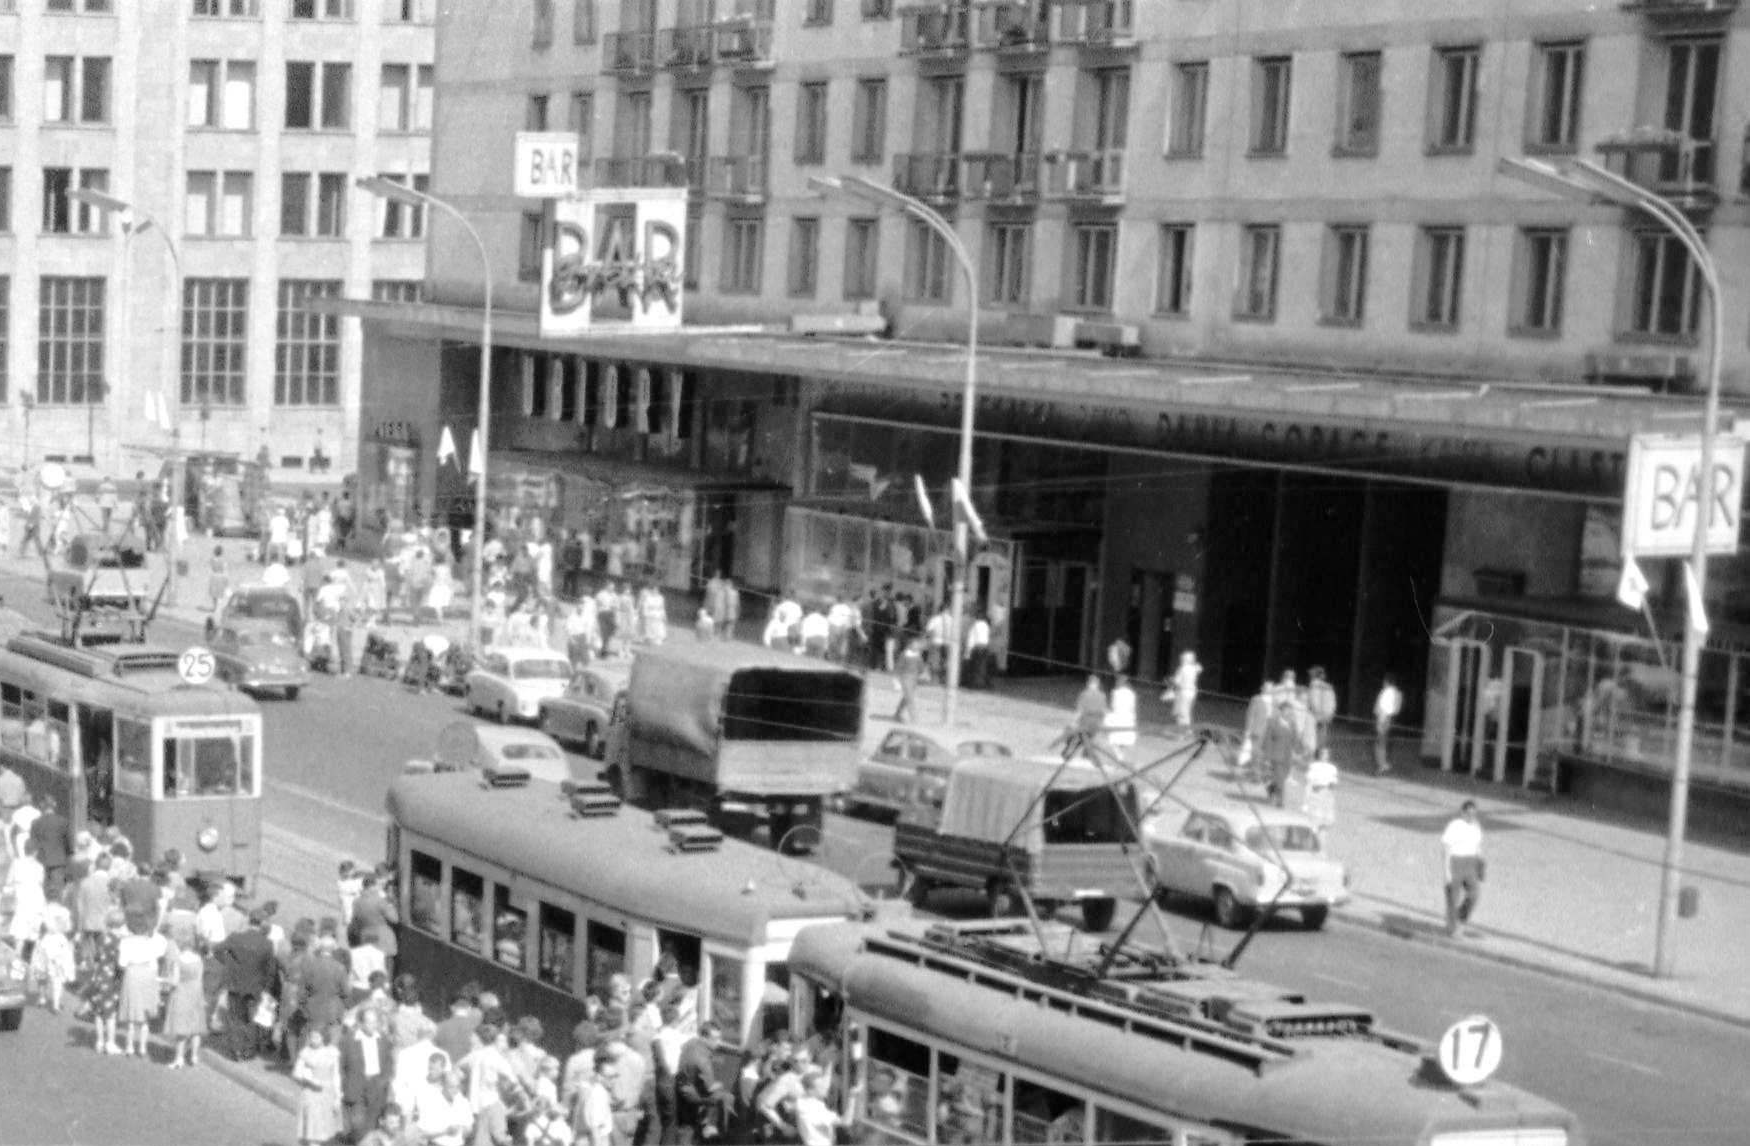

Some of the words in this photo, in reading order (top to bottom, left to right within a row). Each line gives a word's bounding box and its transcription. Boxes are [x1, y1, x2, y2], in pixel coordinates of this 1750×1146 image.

[530, 149, 572, 185] BAR
[549, 219, 679, 317] BAR
[1650, 463, 1734, 531] BAR
[182, 653, 213, 678] 25
[1452, 1022, 1491, 1071] 17
